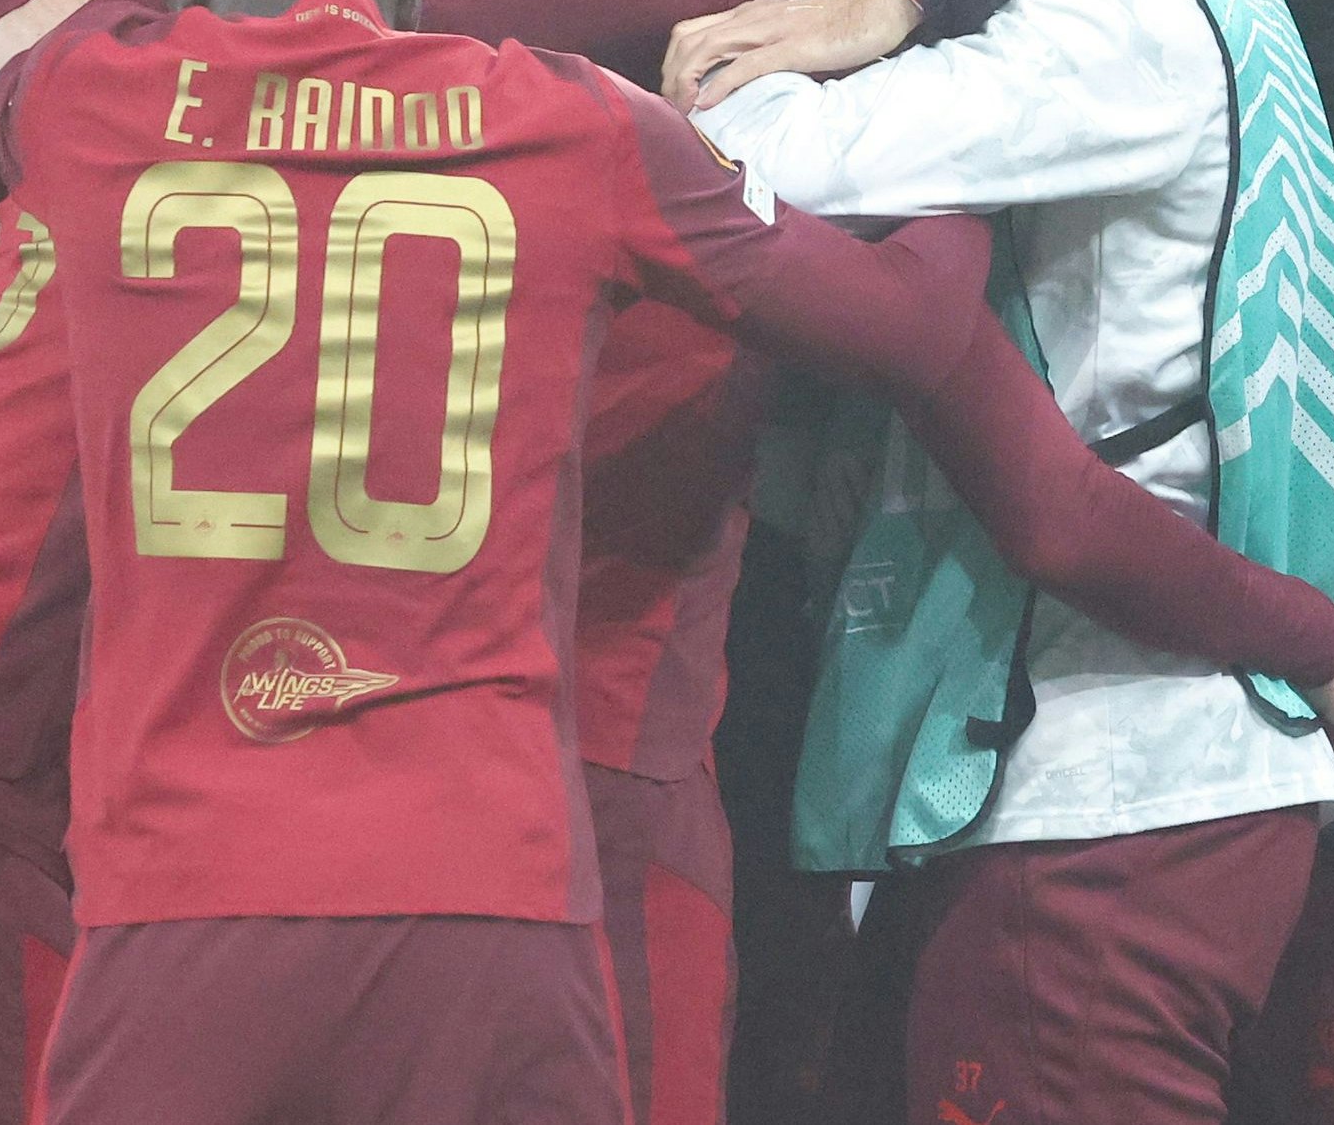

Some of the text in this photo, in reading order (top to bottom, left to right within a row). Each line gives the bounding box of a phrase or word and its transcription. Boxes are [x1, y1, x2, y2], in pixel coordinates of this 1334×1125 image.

[325, 4, 339, 15] IS
[164, 58, 484, 151] E. BAIDOO
[120, 161, 517, 574] 20
[294, 630, 336, 669] SUPPORT
[251, 668, 335, 696] WINGS
[257, 690, 305, 711] LIFE
[955, 1059, 983, 1092] 37
